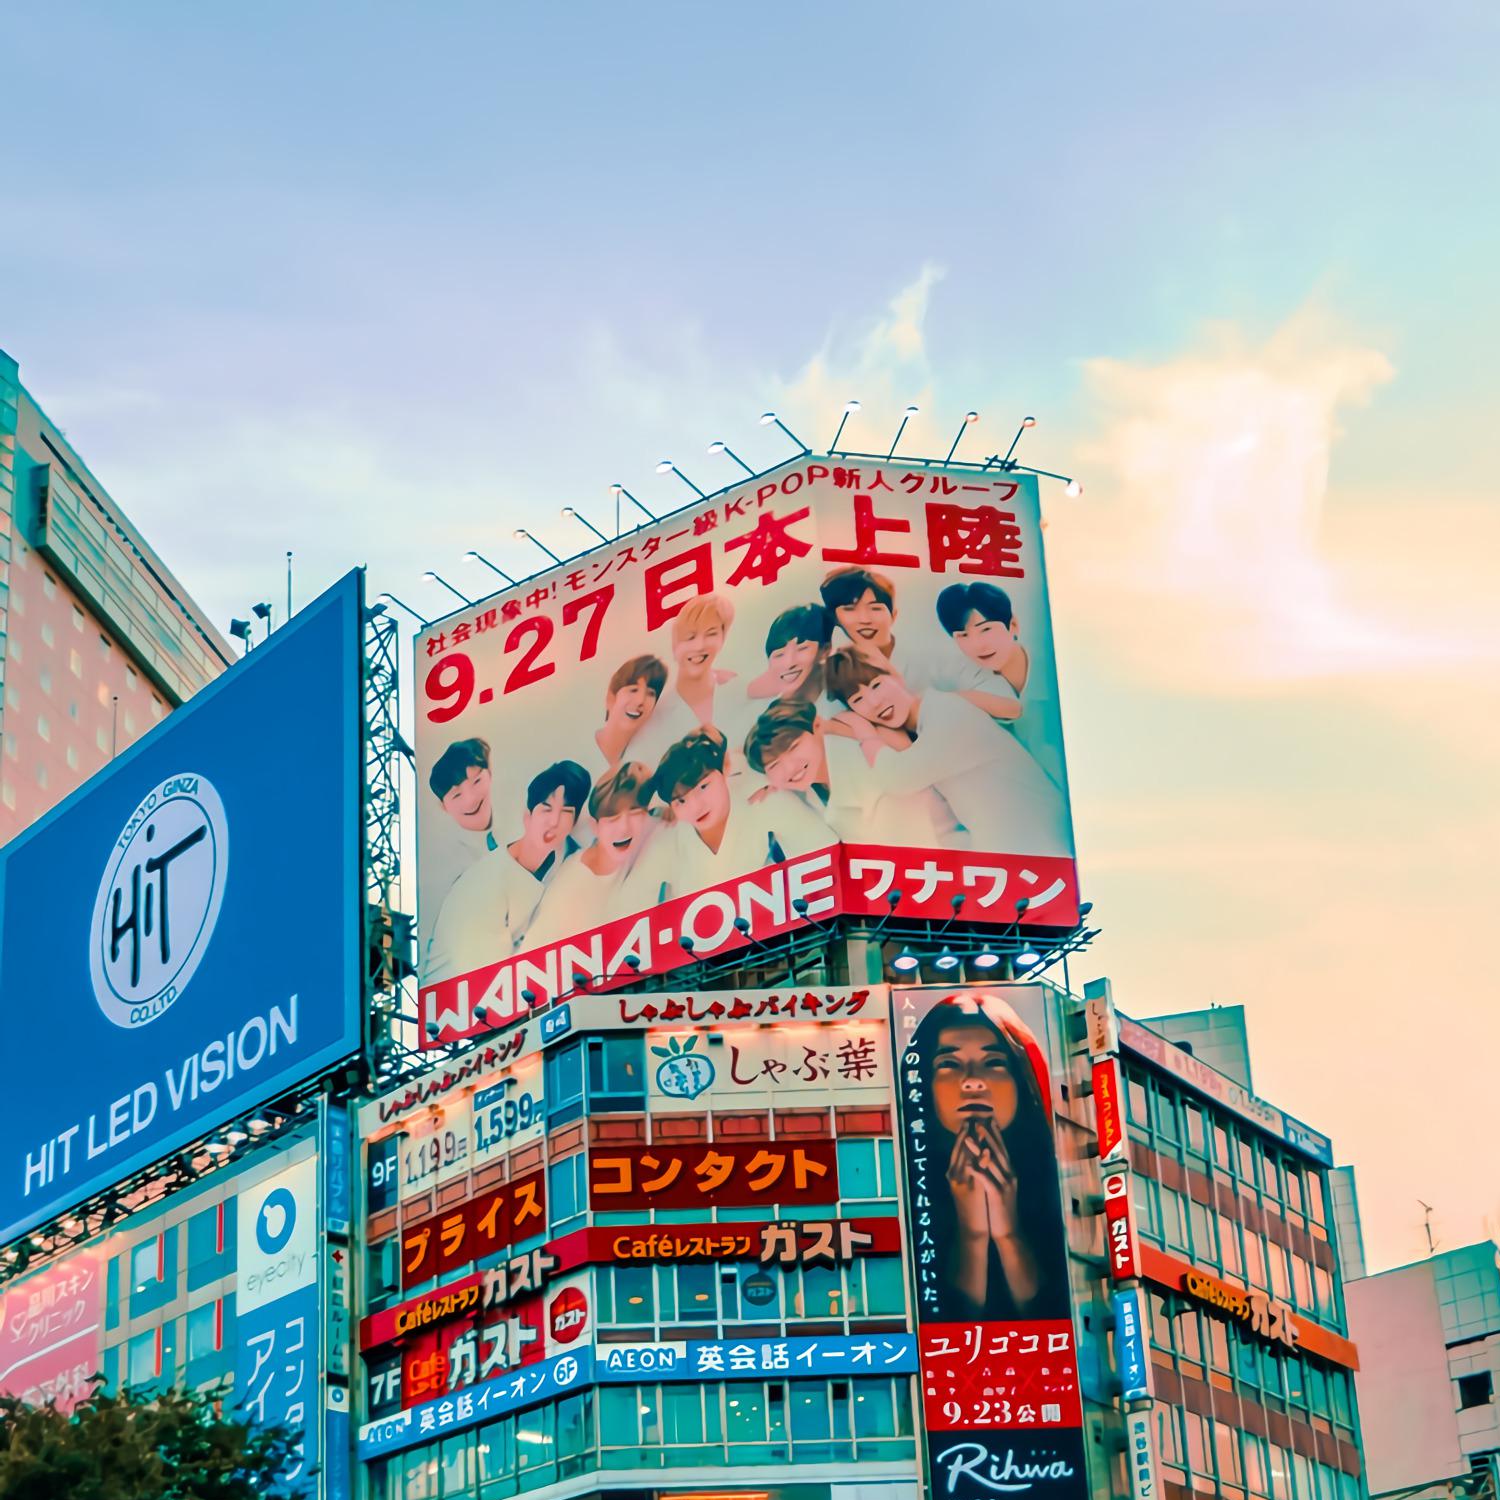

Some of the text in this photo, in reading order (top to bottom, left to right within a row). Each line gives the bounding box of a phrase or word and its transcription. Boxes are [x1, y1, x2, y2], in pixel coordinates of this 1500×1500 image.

[424, 495, 1025, 723] 9.27 日本上陸
[849, 859, 1067, 909] ワナワン
[730, 1037, 878, 1086] しゃぶ葉
[23, 993, 298, 1196] HIT LED VISION
[372, 1155, 397, 1187] 9F
[592, 1148, 829, 1196] コンタクト
[404, 1180, 543, 1273] プライス
[760, 1221, 872, 1264] ガスト
[448, 1316, 537, 1391] ガスト
[608, 1342, 908, 1371] AEON 英会話イーオン
[924, 1325, 1070, 1365] ユリゴコロ
[370, 1367, 401, 1405] 7F
[419, 1371, 546, 1434] 英会話イーオン
[936, 1442, 1074, 1493] Rihwa
